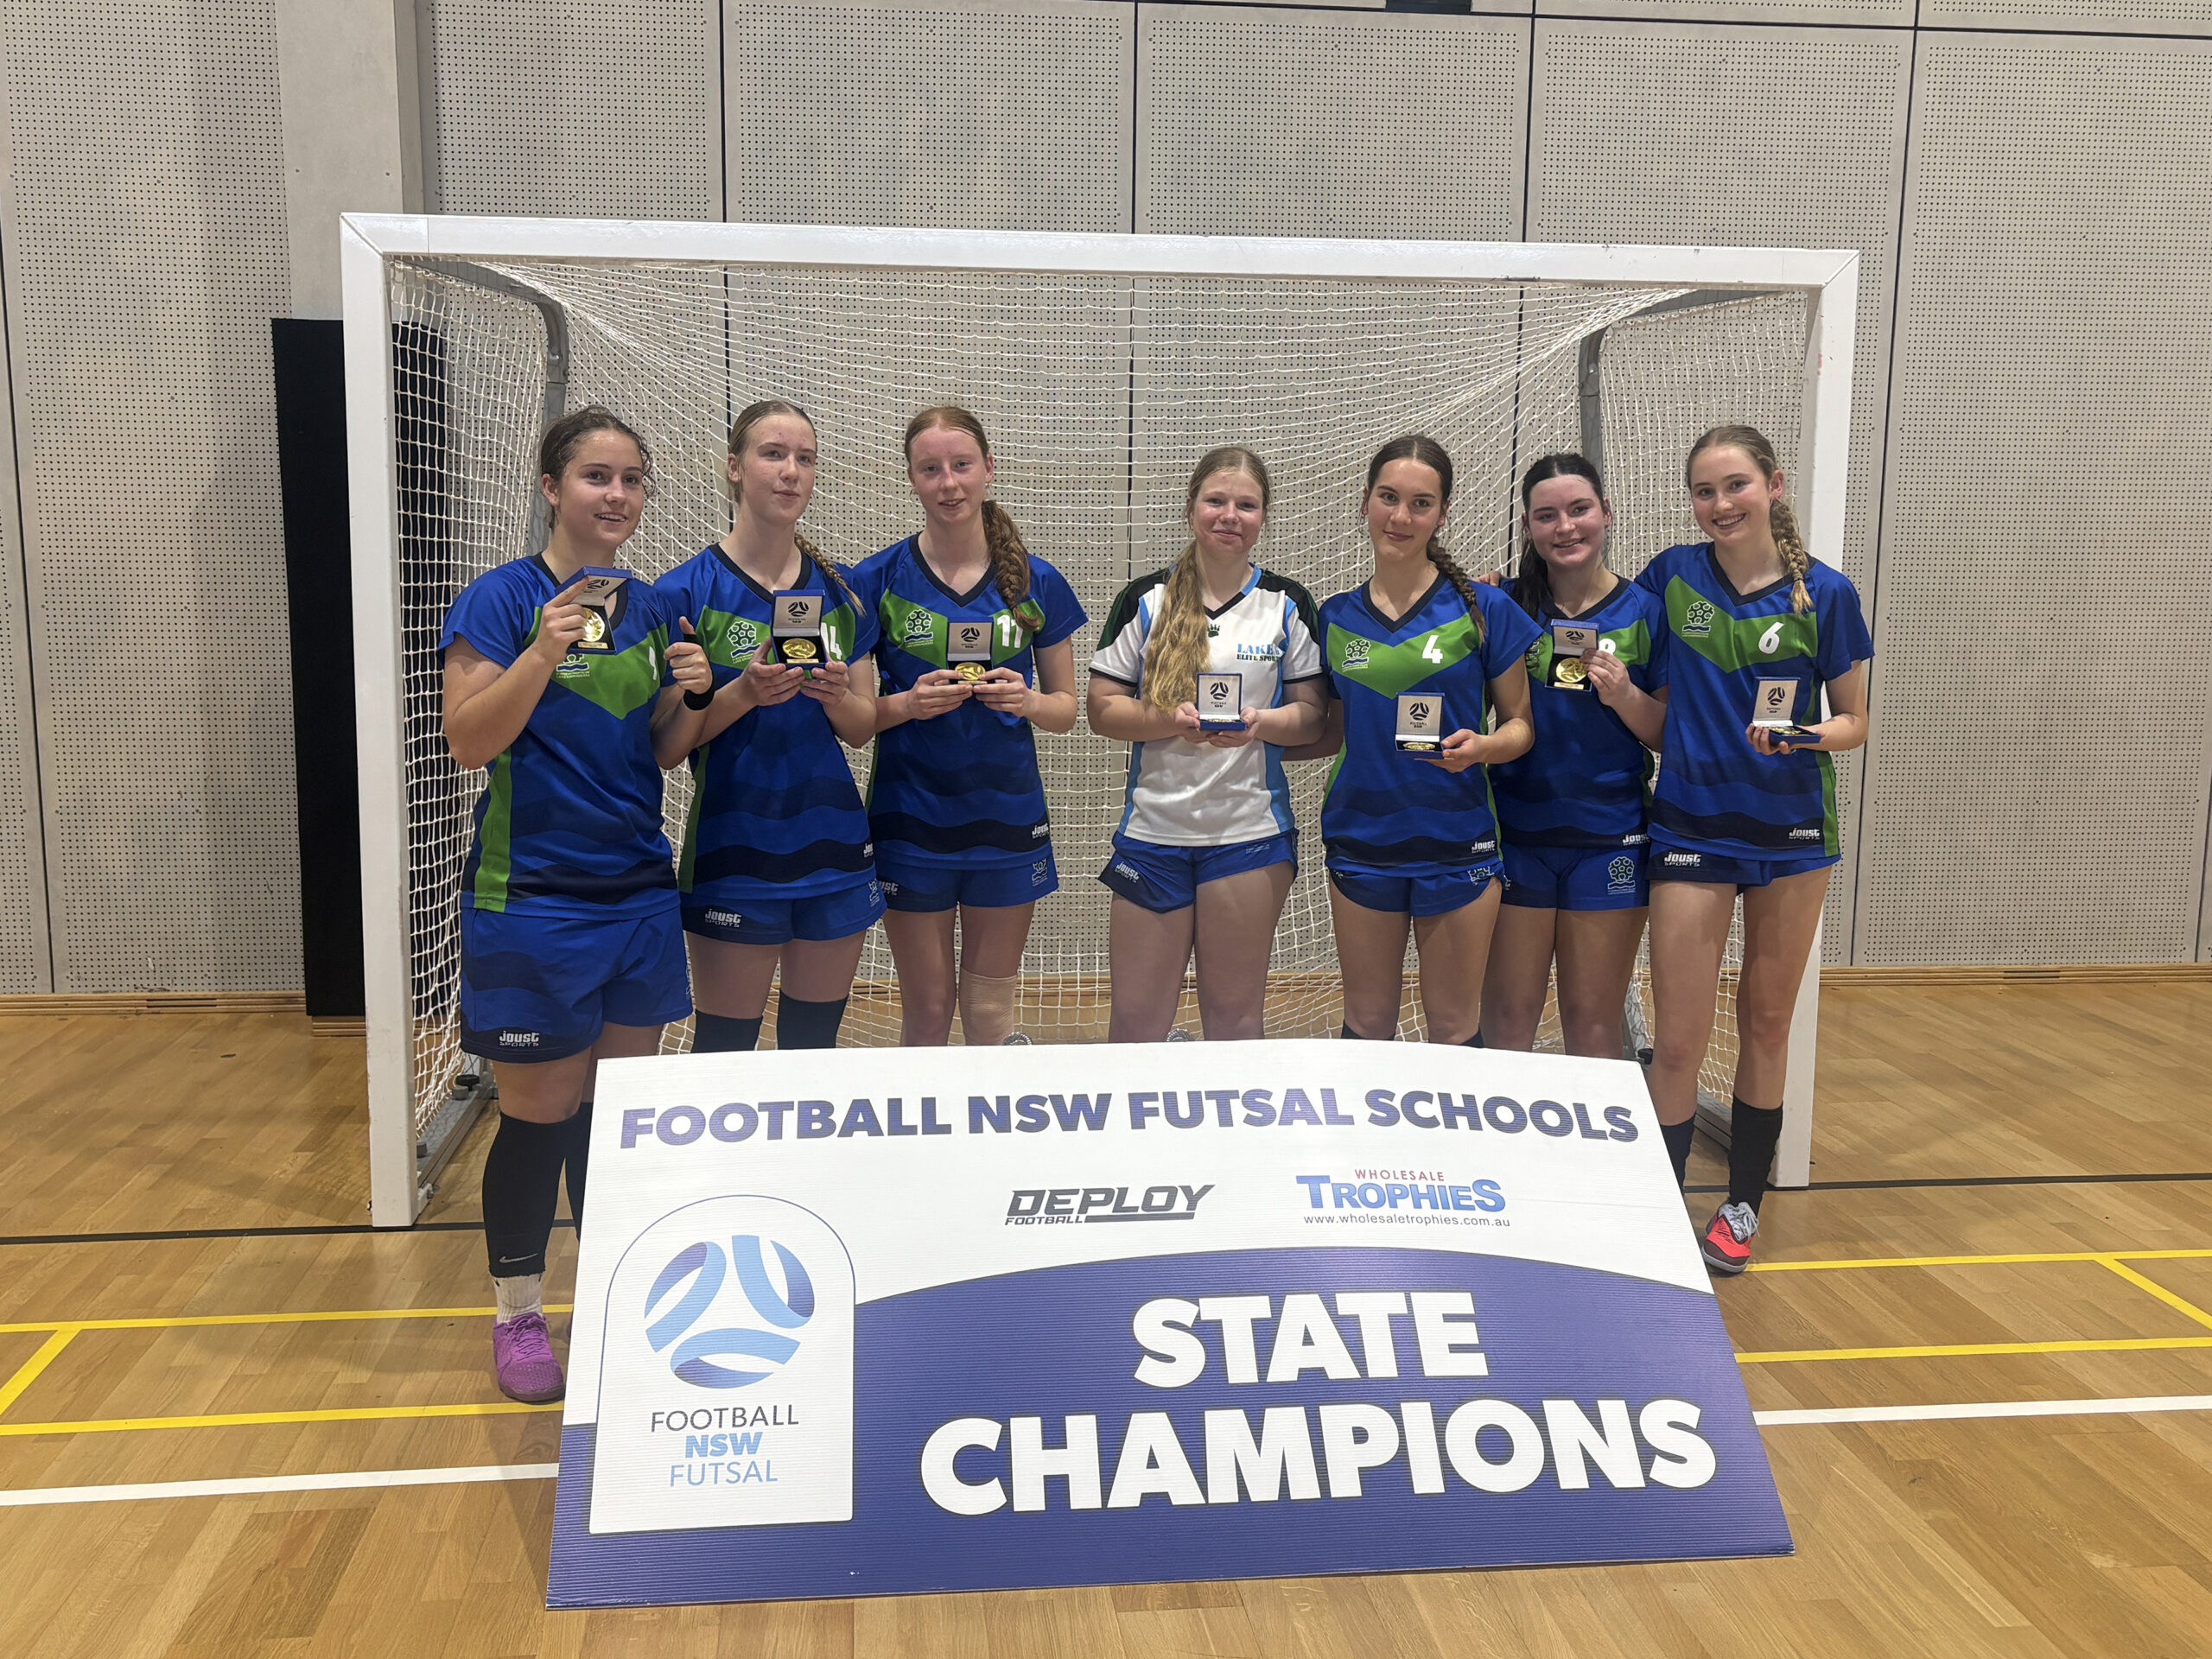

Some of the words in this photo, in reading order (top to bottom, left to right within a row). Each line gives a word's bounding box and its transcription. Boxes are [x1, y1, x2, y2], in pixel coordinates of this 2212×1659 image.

[1422, 635, 1444, 664] 4
[1758, 622, 1784, 654] 6
[620, 1097, 951, 1148] FOOTBALL
[968, 1093, 1112, 1134] NSW
[1128, 1089, 1354, 1129] FUTSAL
[1367, 1090, 1639, 1142] SCHOOLS
[1355, 1169, 1445, 1182] WHOLESALE
[1007, 1185, 1216, 1217] DEPLOY
[1005, 1215, 1083, 1226] FOOTBALL
[1303, 1213, 1510, 1227] www.wholesaletrophies.com.au
[1134, 1292, 1488, 1388] STATE
[651, 1404, 799, 1433] FOOTBALL
[685, 1431, 763, 1459] NSW
[920, 1399, 1717, 1516] CHAMPIONS
[670, 1459, 779, 1488] FUTSAL
